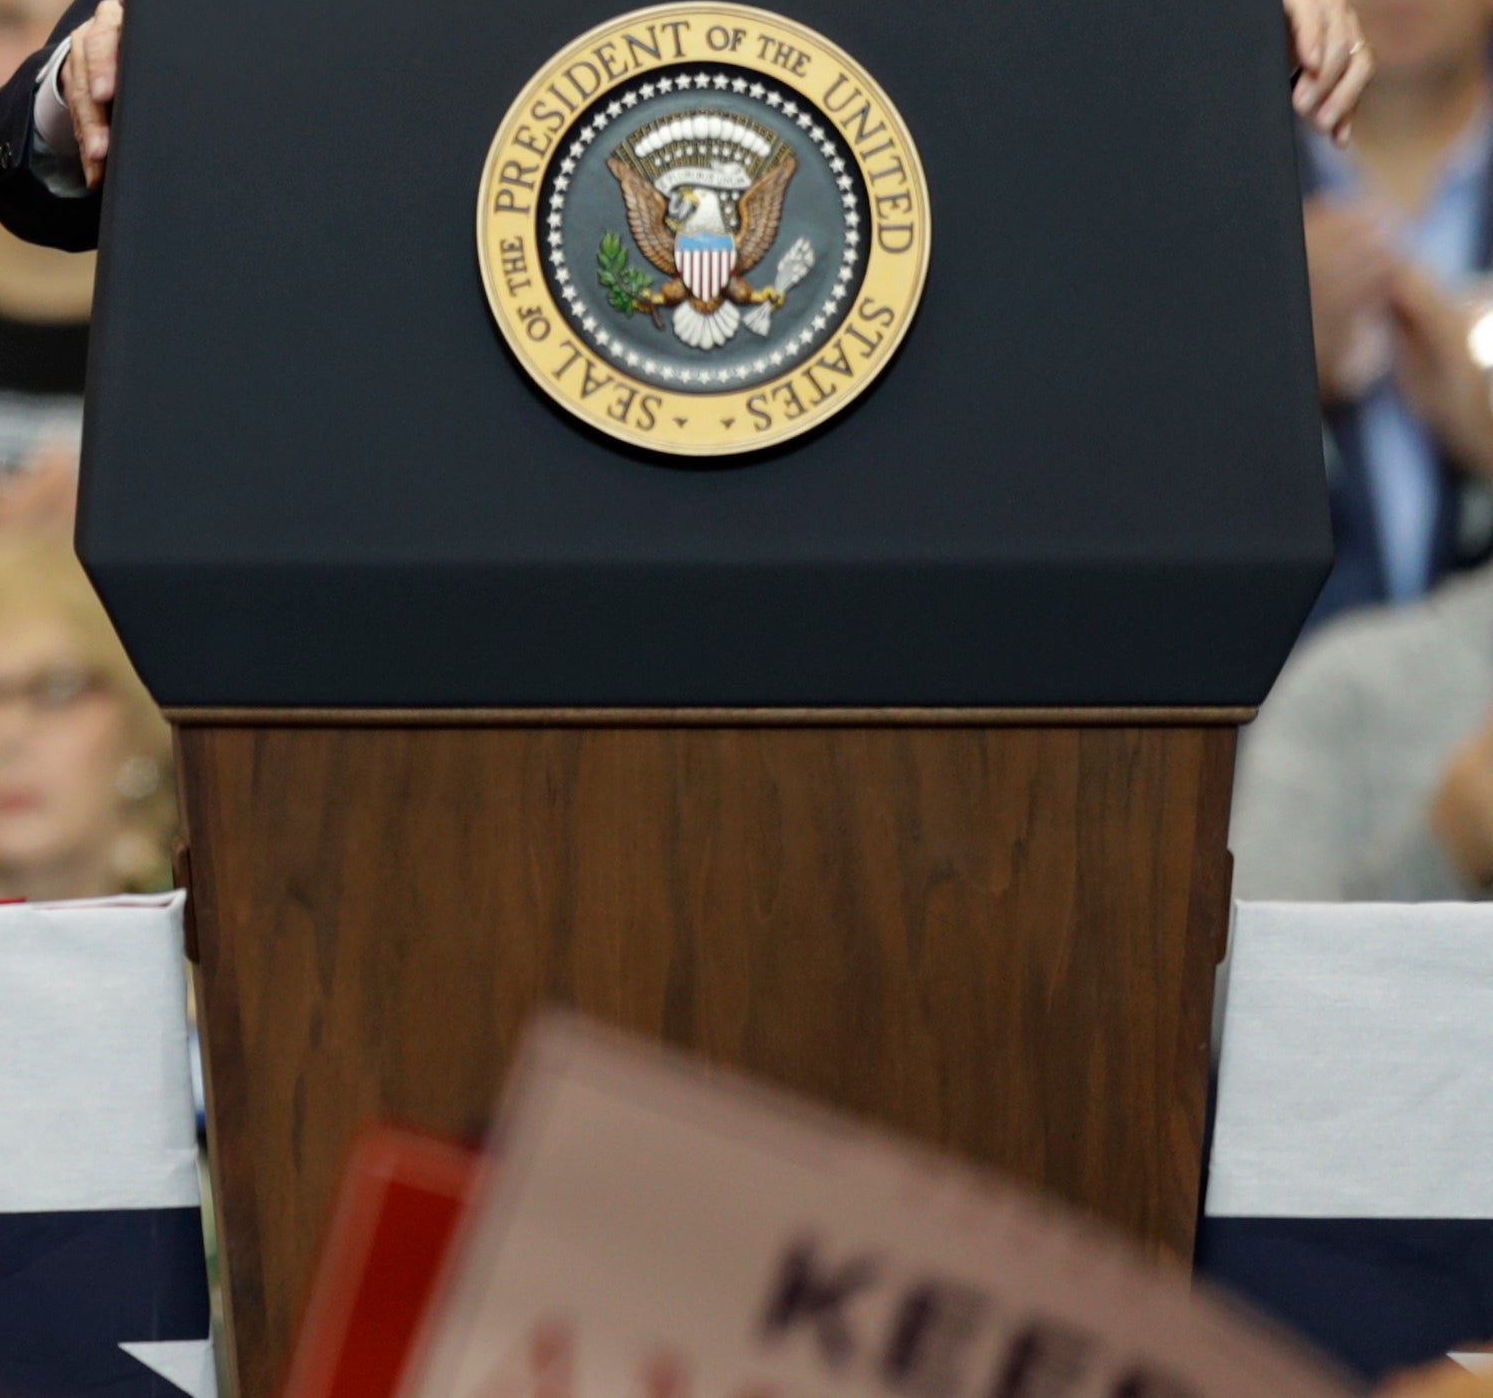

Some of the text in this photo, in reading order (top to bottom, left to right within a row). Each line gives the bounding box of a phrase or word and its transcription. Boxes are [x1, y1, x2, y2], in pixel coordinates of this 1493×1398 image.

[493, 20, 915, 433] SEAL OF THE PRESIDENT OF THE UNITED STATES
